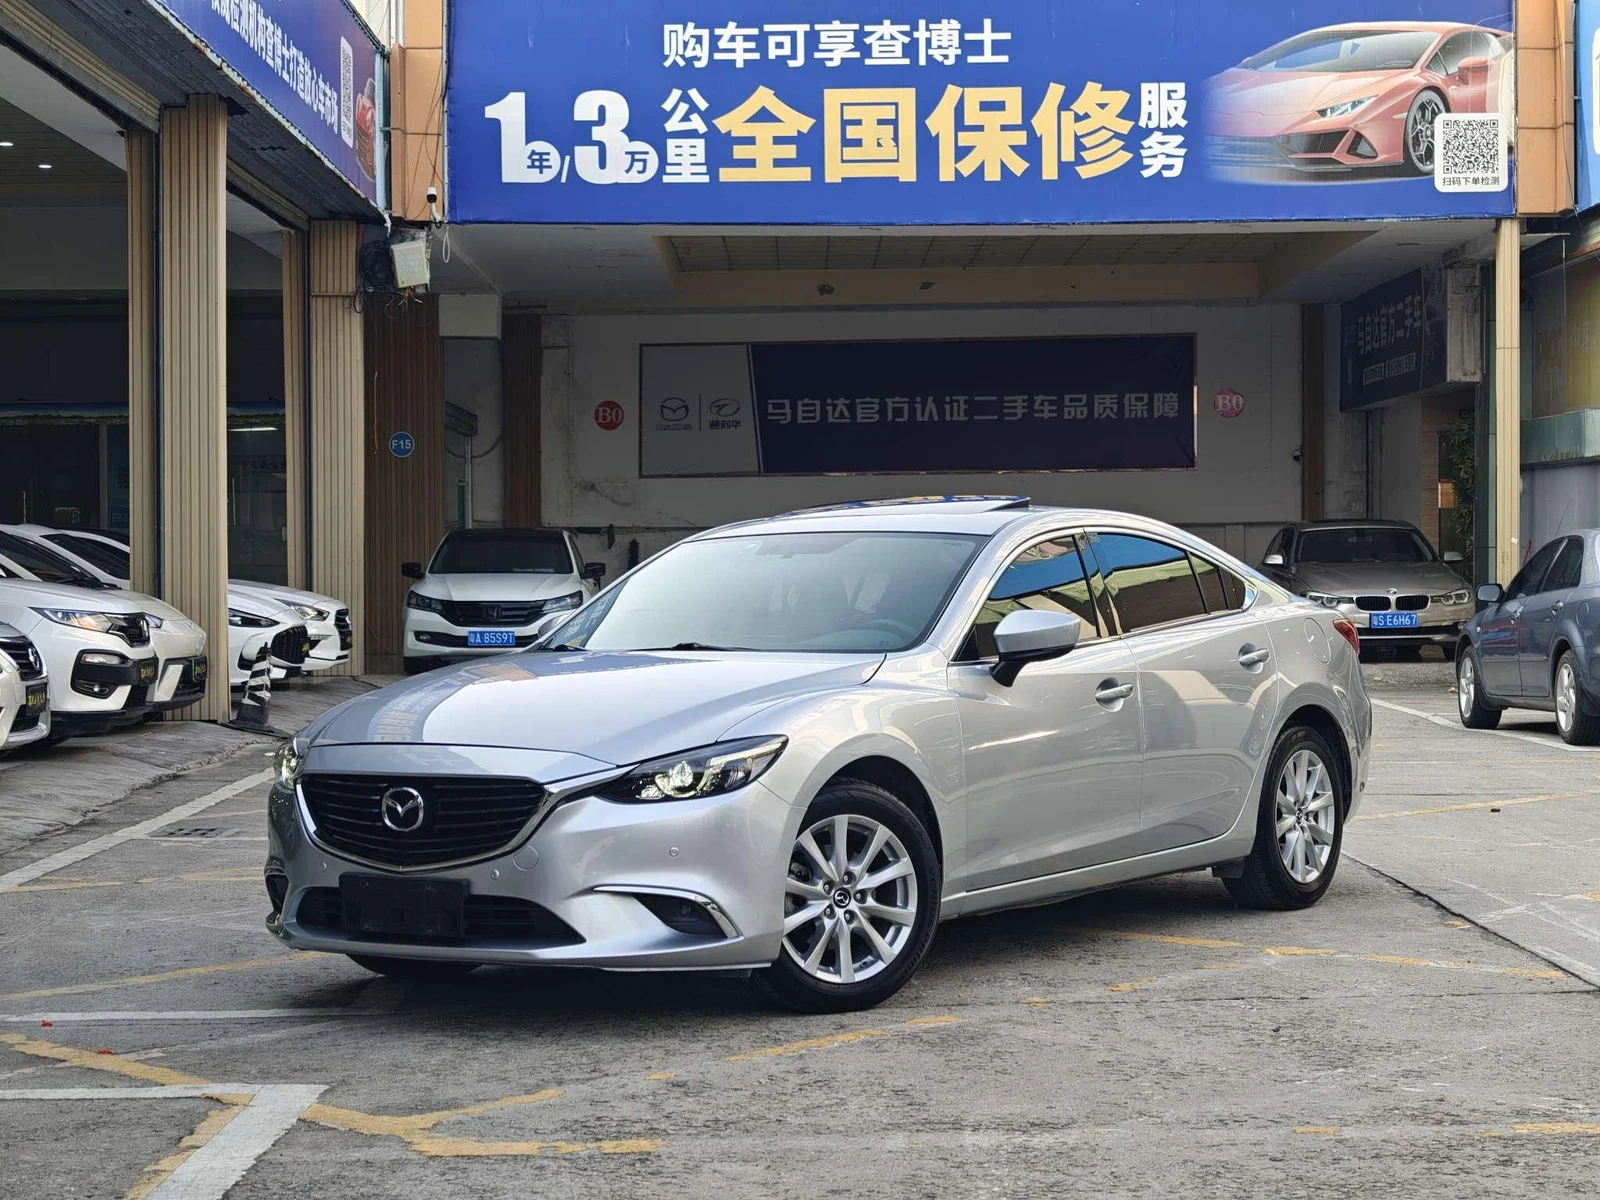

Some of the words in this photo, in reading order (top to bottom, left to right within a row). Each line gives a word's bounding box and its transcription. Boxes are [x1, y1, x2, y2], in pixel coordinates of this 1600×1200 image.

[663, 18, 1011, 68] 购车可享查博士
[1442, 176, 1500, 187] 扫码下单检测
[767, 392, 1180, 424] 马自达官方认证二手车品质保障
[391, 439, 411, 450] F15
